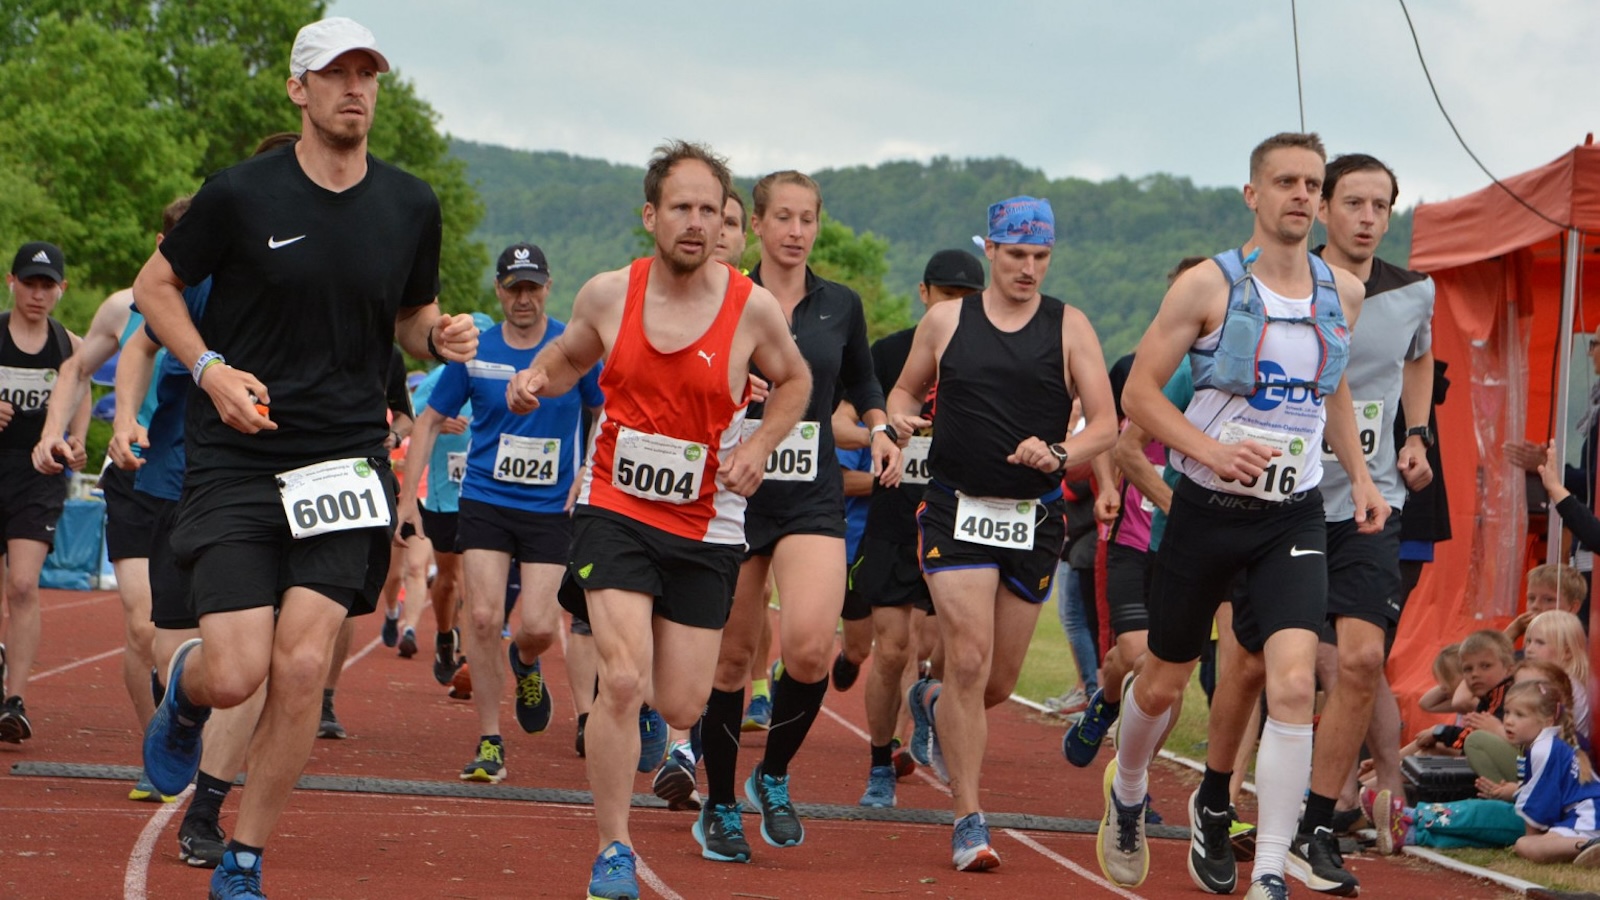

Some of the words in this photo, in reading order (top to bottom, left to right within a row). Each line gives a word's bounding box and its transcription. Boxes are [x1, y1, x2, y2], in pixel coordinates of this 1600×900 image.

[498, 456, 553, 479] 4024
[618, 457, 694, 499] 5004
[292, 488, 379, 529] 6001
[1208, 493, 1262, 511] NIKE
[960, 515, 1029, 543] 4058
